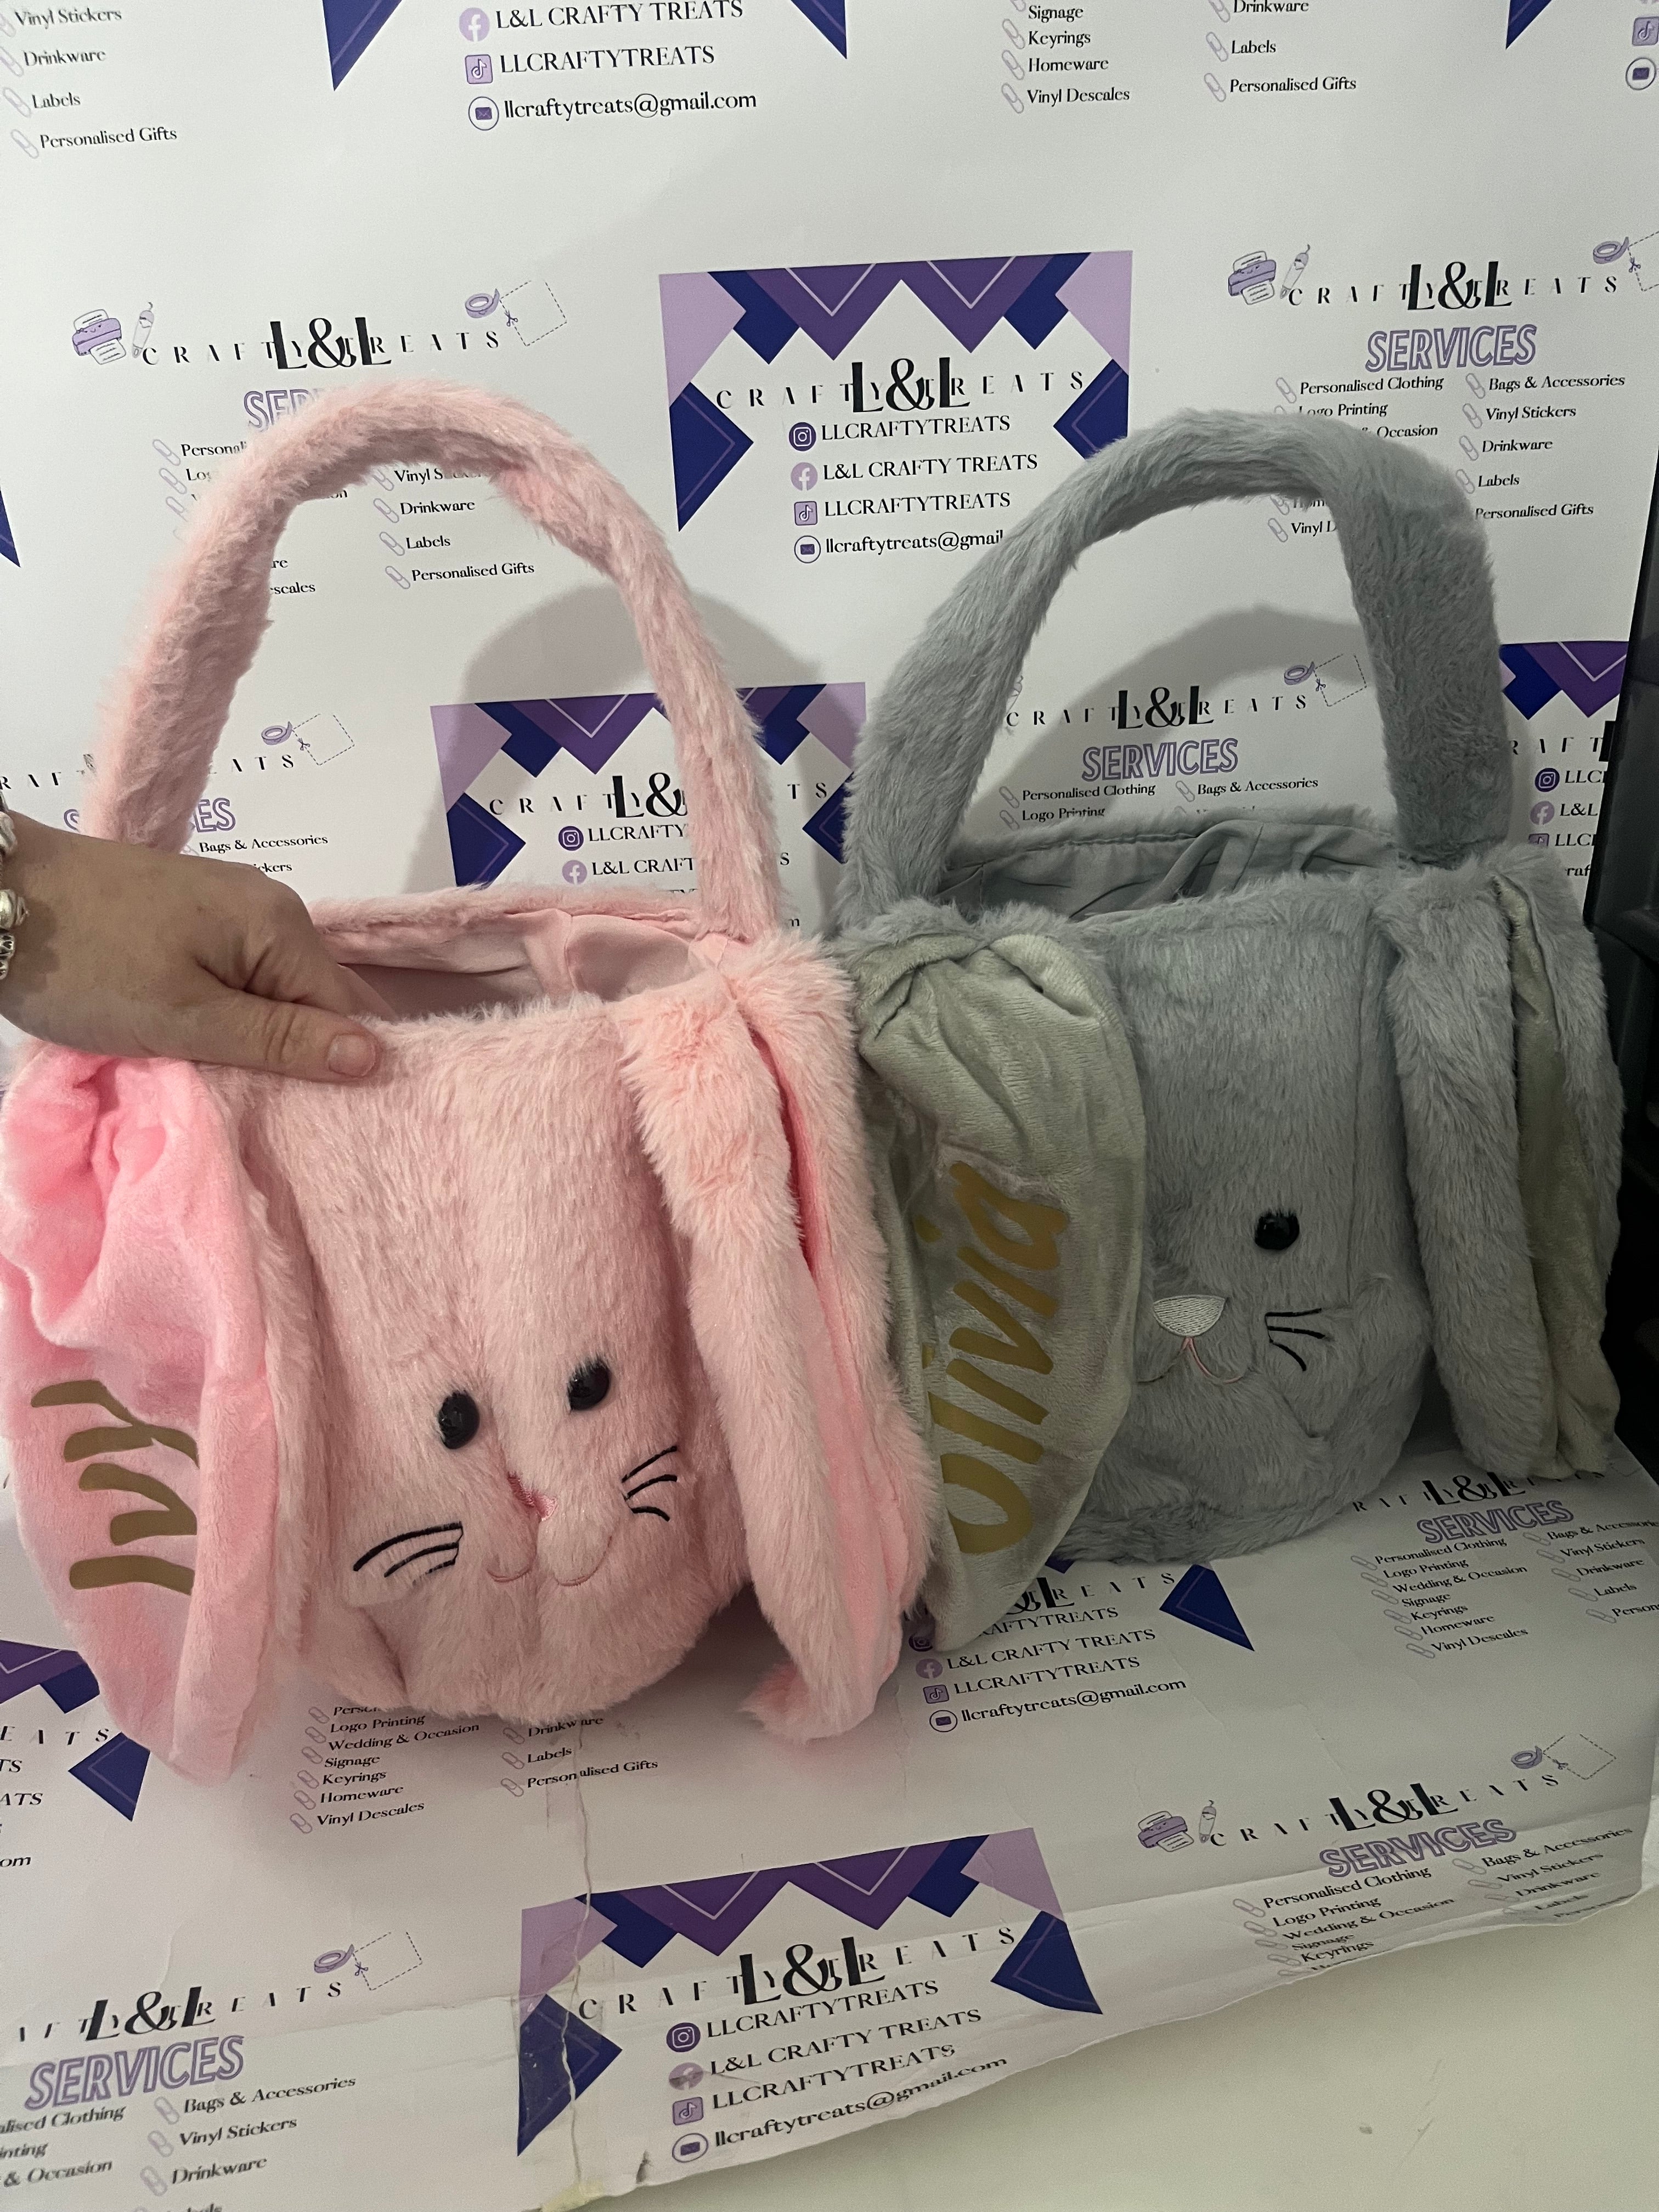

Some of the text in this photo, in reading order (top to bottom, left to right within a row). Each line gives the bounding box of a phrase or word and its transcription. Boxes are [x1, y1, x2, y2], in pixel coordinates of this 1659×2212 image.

[496, 0, 743, 29] L&L CRAFTY TREATS
[1028, 5, 1084, 24] Signage
[1233, 0, 1309, 13] Drinkware
[14, 7, 122, 30] Vinyl Stickers
[1029, 30, 1091, 49] Keyrings
[1232, 40, 1276, 54] Labels
[23, 49, 106, 66] Drinkware
[500, 46, 714, 73] LLCRAFTYTREATS
[1029, 58, 1109, 72] Homeware
[1230, 76, 1356, 93] Personalised Gifts
[32, 92, 81, 109] Labels
[504, 91, 757, 122] llcraftytreats@gmail.com
[1027, 86, 1130, 108] Vinyl Descales
[40, 126, 177, 149] Personalised Gifts
[1407, 261, 1513, 311] L&L
[269, 316, 392, 370] L&L
[1365, 324, 1538, 373] SERVICES
[851, 356, 970, 413] L&L
[1300, 375, 1444, 395] Personalised Clothing
[1489, 374, 1626, 393] Bags & Accessories
[1338, 402, 1389, 417] Printing
[1486, 405, 1576, 424] Vinyl Stickers
[821, 415, 1010, 441] LLCRAFTYTREATS
[1376, 424, 1438, 439] Occasion
[1482, 439, 1553, 453] Drinkware
[394, 467, 431, 486] Vinyl
[823, 454, 1037, 480] L&L CRAFTY TREATS
[1478, 473, 1520, 488] Labels
[400, 500, 475, 515] Drinkware
[825, 492, 1011, 517] LLCRAFTYTREATS
[1475, 503, 1594, 521] Personalised Gifts
[1290, 521, 1323, 537] Vinyl
[405, 535, 451, 549] Labels
[411, 562, 534, 582] Personalised Gifts
[1116, 685, 1214, 730] L&L
[1081, 737, 1239, 782] SERVICES
[1023, 783, 1156, 801] Personalised Clothing
[1198, 777, 1318, 797] Bags & Accessories
[1022, 806, 1105, 823] Logo Printing
[1559, 803, 1598, 816] L&L
[199, 835, 328, 854] Bags & Accessories
[591, 861, 630, 876] L&L
[914, 1160, 1070, 1555] Olivia
[1422, 1471, 1526, 1506] L&L
[1417, 1500, 1574, 1544] SERVICES
[1546, 1530, 1579, 1540] Bags
[1579, 1526, 1594, 1534] &
[1374, 1538, 1508, 1565] Personalised Clothing
[1559, 1539, 1645, 1557] Vinyl Stickers
[1383, 1559, 1469, 1578] Logo Printing
[1576, 1560, 1644, 1576] Drinkware
[1392, 1567, 1528, 1593] Wedding & Occasion
[1593, 1583, 1637, 1596] Labels
[1401, 1594, 1451, 1607] Signage
[1410, 1606, 1468, 1621] Keyrings
[1420, 1616, 1494, 1635] Homeware
[947, 1629, 1156, 1669] L&L CRAFTY TREATS
[1430, 1629, 1528, 1651] Vinyl Descales
[953, 1656, 1141, 1695] LLCRAFTYTREATS
[961, 1678, 1187, 1722] llcraftytreats@gmail.com
[330, 1715, 426, 1733] Logo Printing
[528, 1716, 603, 1737] Drinkware
[328, 1724, 479, 1751] Wedding & Occasion
[324, 1757, 380, 1769] Signage
[527, 1747, 572, 1763] Labels
[322, 1771, 387, 1786] Keyrings
[527, 1760, 658, 1788] Personalised Gifts
[320, 1787, 404, 1803] Homeware
[317, 1803, 425, 1826] Vinyl Descales
[1329, 1782, 1458, 1832] L&L
[1318, 1818, 1517, 1877] SERVICES
[1481, 1827, 1633, 1868] Bags & Accessories
[1497, 1853, 1604, 1883] Vinyl Stickers
[1263, 1867, 1432, 1909] Personalised Clothing
[1515, 1872, 1601, 1897] Drinkware
[1272, 1897, 1382, 1927] Logo Printing
[1282, 1898, 1455, 1941] Wedding & Occasion
[1301, 1941, 1375, 1963] Keyrings
[738, 1936, 885, 2006] L&L
[85, 1986, 216, 2042] L&L
[707, 1979, 939, 2039] LLCRAFTYTREATS
[710, 2008, 982, 2076] L&L CRAFTY TREATS
[24, 2034, 245, 2111] SERVICES
[713, 2044, 956, 2110] LLCRAFTYTREATS
[184, 2078, 356, 2114] Bags & Accessories
[715, 2058, 1008, 2147] llcraftytreats@gmail.com
[50, 2105, 127, 2128] Clothing
[179, 2119, 297, 2146] Vinyl Stickers
[26, 2159, 113, 2183] Occasion
[172, 2158, 267, 2185] Drinkware
